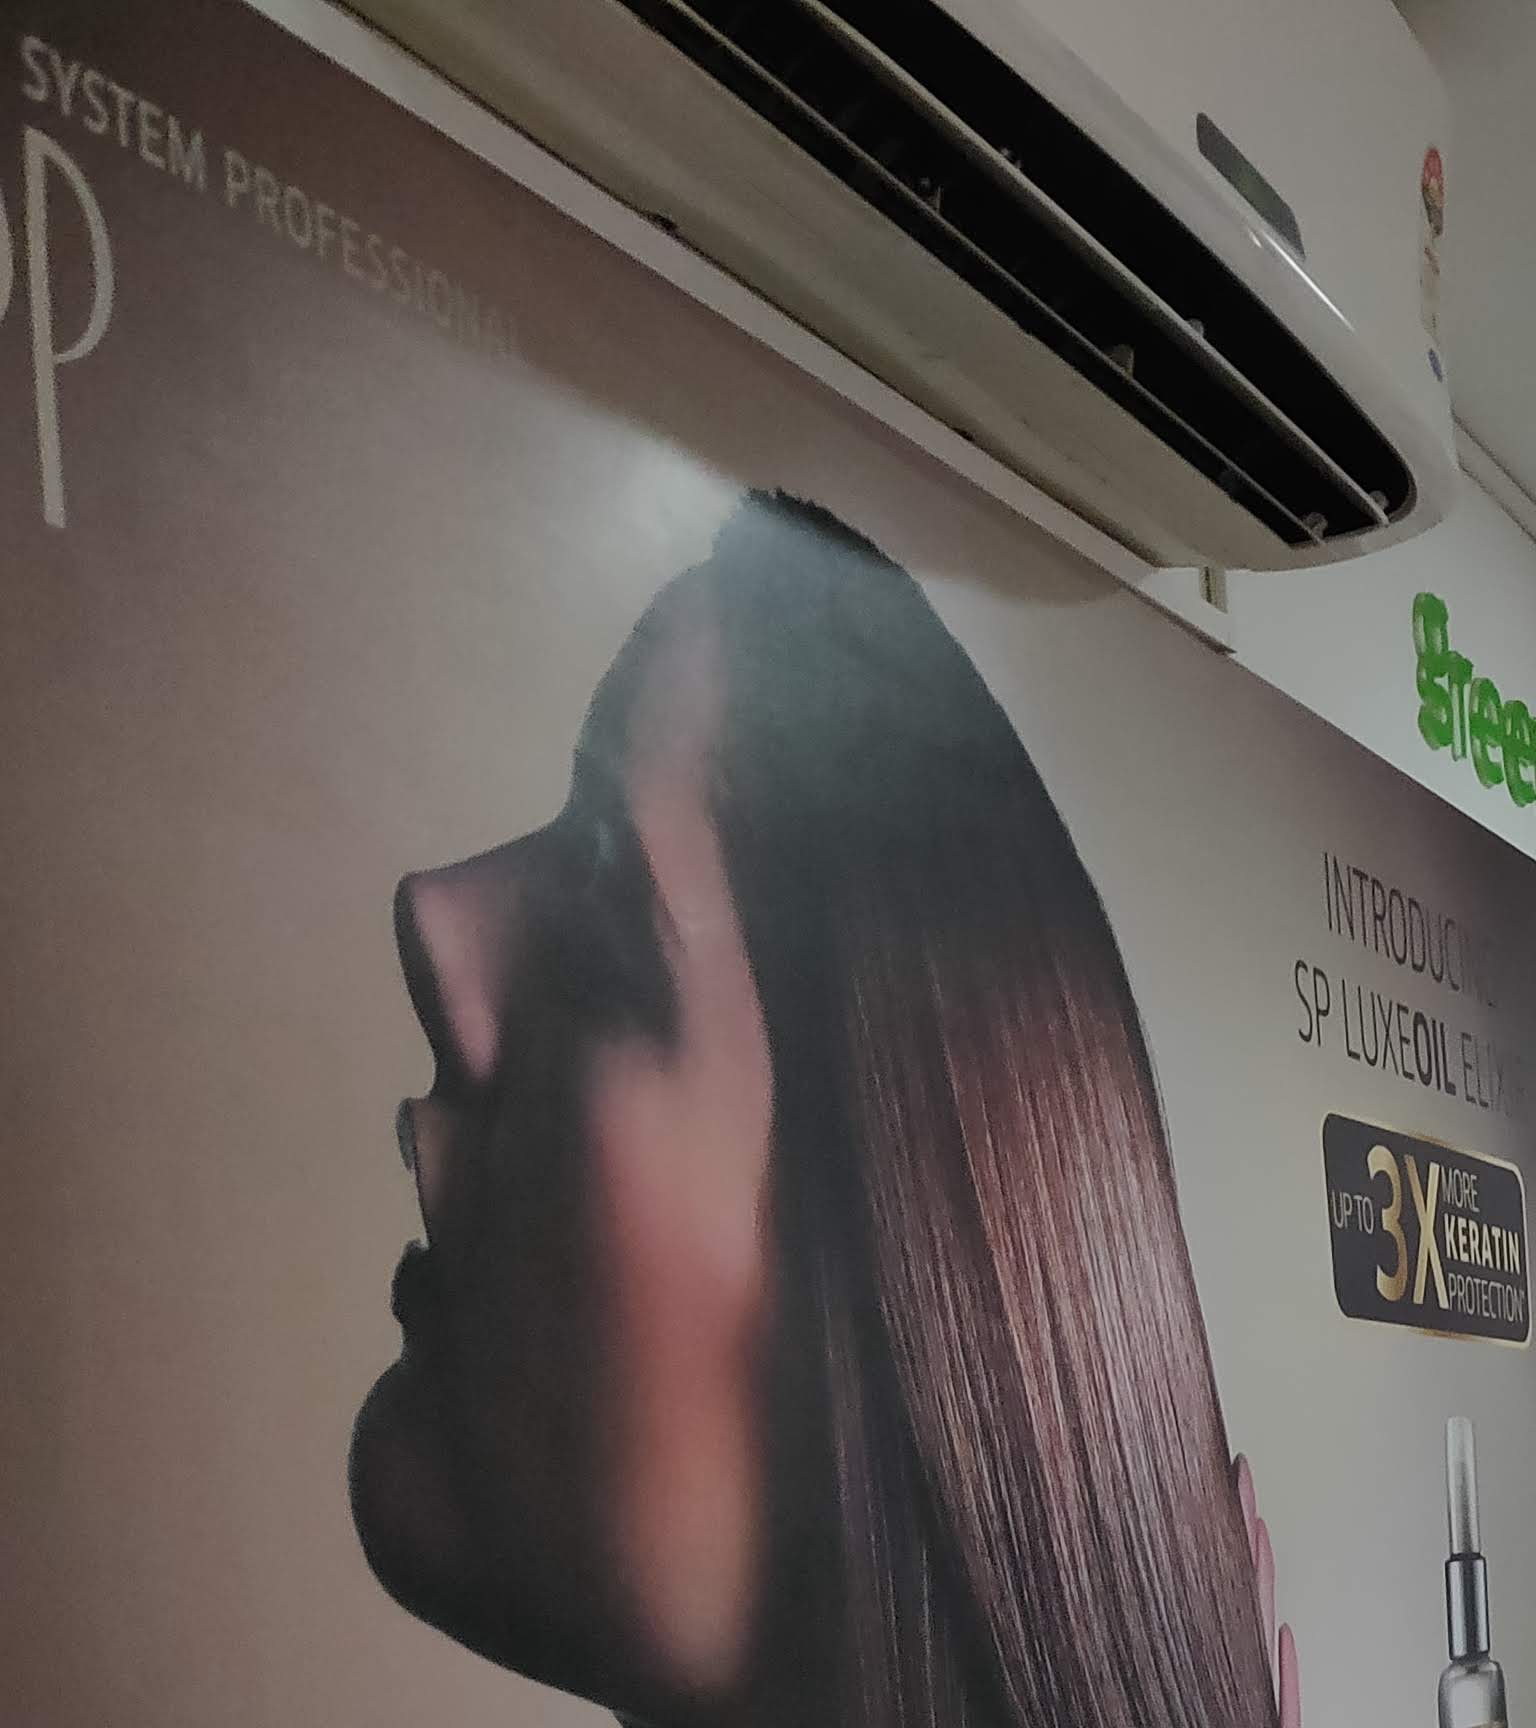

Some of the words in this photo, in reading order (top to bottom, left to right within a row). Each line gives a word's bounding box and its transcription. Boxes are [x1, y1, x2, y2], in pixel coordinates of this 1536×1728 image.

[20, 35, 207, 192] SYSTEM
[0, 125, 116, 530] p
[1324, 852, 1496, 1008] INTRODUC
[1295, 960, 1331, 1047] SP
[1342, 978, 1457, 1096] LUXEOIL
[1331, 1191, 1351, 1229] UP
[1354, 1194, 1374, 1235] TO
[1367, 1144, 1450, 1310] 3X
[1440, 1166, 1480, 1213] MORE
[1443, 1212, 1521, 1276] KERATIN
